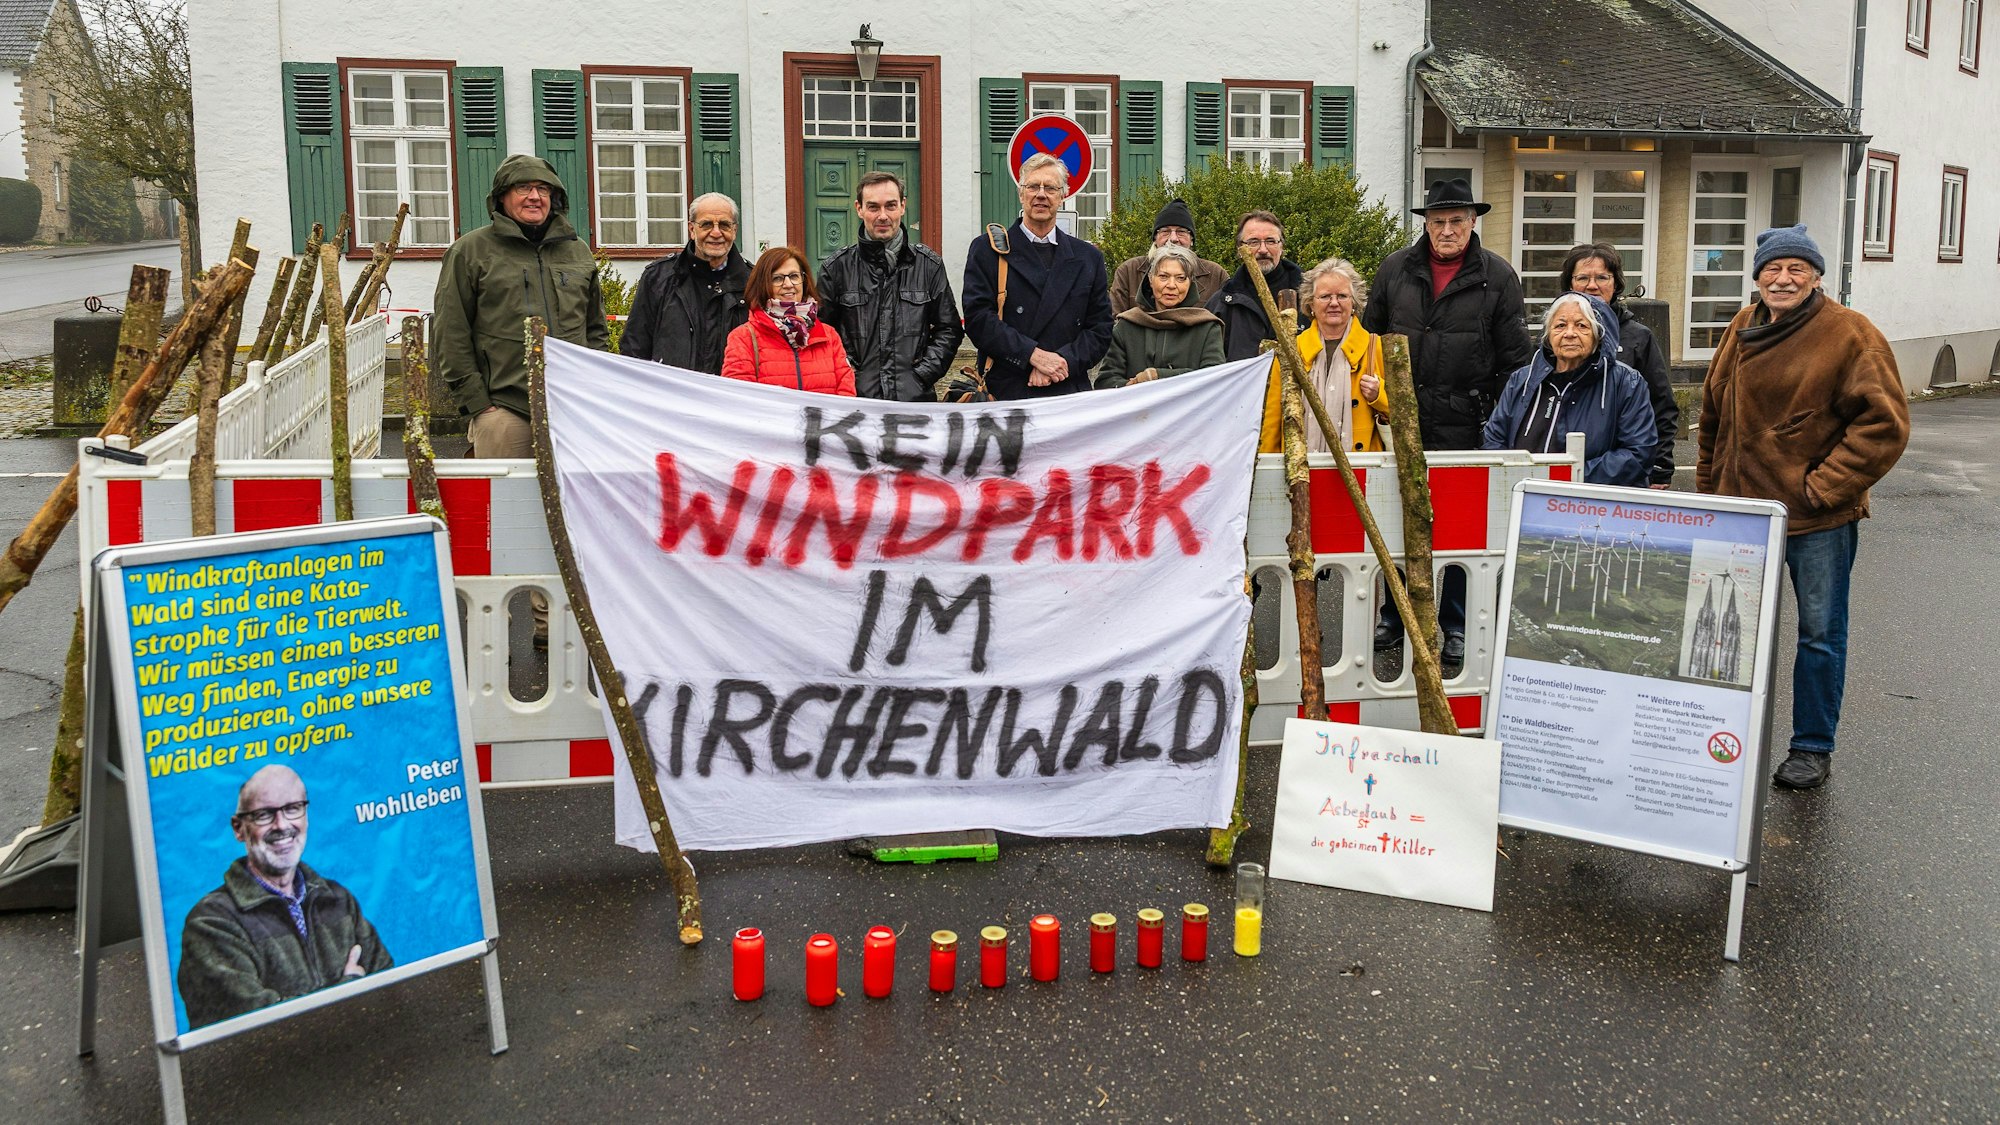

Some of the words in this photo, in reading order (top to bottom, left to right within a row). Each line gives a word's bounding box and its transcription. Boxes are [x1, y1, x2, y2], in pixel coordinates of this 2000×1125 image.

[1601, 204, 1633, 212] EINGANG
[802, 405, 1029, 476] KEIN
[656, 451, 1210, 569] WINDPARK
[1546, 498, 1608, 517] Schöne
[1611, 504, 1716, 527] Aussichten?
[358, 546, 385, 568] im
[130, 595, 194, 627] Wald
[201, 588, 251, 618] sind
[256, 587, 303, 611] eine
[309, 580, 370, 605] Kata-
[134, 625, 229, 658] strophe
[235, 621, 269, 648] für
[275, 611, 309, 637] die
[315, 598, 408, 630] Tierwelt.
[848, 569, 994, 673] IM
[1546, 621, 1661, 644] www.windpark-wackerberg.de
[137, 663, 180, 688] Wir
[187, 648, 275, 680] müssen
[281, 637, 343, 664] einen
[349, 623, 441, 654] besseren
[141, 690, 196, 721] Weg
[202, 675, 283, 714] finden,
[287, 664, 370, 697] Energie
[375, 656, 399, 676] zu
[1512, 674, 1525, 682] Der
[1526, 676, 1573, 690] (potentielle)
[1574, 684, 1607, 696] Investor:
[1636, 704, 1661, 712] Initiative
[1662, 707, 1690, 718] Windpark
[1690, 712, 1726, 724] Wackerberg
[1650, 696, 1681, 707] Weitere
[1682, 700, 1705, 711] Infos:
[145, 709, 295, 753] produzieren,
[301, 692, 355, 719] ohne
[361, 678, 432, 706] unsere
[1511, 716, 1524, 724] Die
[1524, 718, 1574, 733] Waldbesitzer:
[1666, 717, 1690, 727] Manfred
[1691, 721, 1713, 730] Kanzler
[1508, 726, 1539, 736] Katholische
[1540, 730, 1586, 744] Kirchengemeinde
[1633, 721, 1667, 733] Wackerberg
[149, 742, 238, 778] Wälder
[244, 739, 268, 761] zu
[274, 723, 353, 755] opfern.
[1631, 738, 1700, 755] kanzler@wackerberg.de
[1506, 752, 1543, 764] Arenbergische
[406, 757, 459, 784] Peter
[1503, 771, 1531, 780] Gemeinde
[1660, 769, 1675, 778] Jahre
[1634, 777, 1661, 786] erwarten
[1661, 780, 1695, 792] Pachterlöse
[355, 785, 462, 824] Wohlleben
[1634, 784, 1646, 792] EUR
[1670, 792, 1681, 800] pro
[1682, 792, 1694, 800] Jahr
[1695, 795, 1707, 803] und
[1708, 797, 1733, 808] Windrad
[1634, 804, 1674, 817] Steuerzahlern
[1675, 804, 1715, 816] Stromkunden
[1716, 810, 1728, 818] und
[1310, 836, 1325, 848] die
[1329, 838, 1378, 854] geheimen
[1392, 836, 1436, 857] Killer
